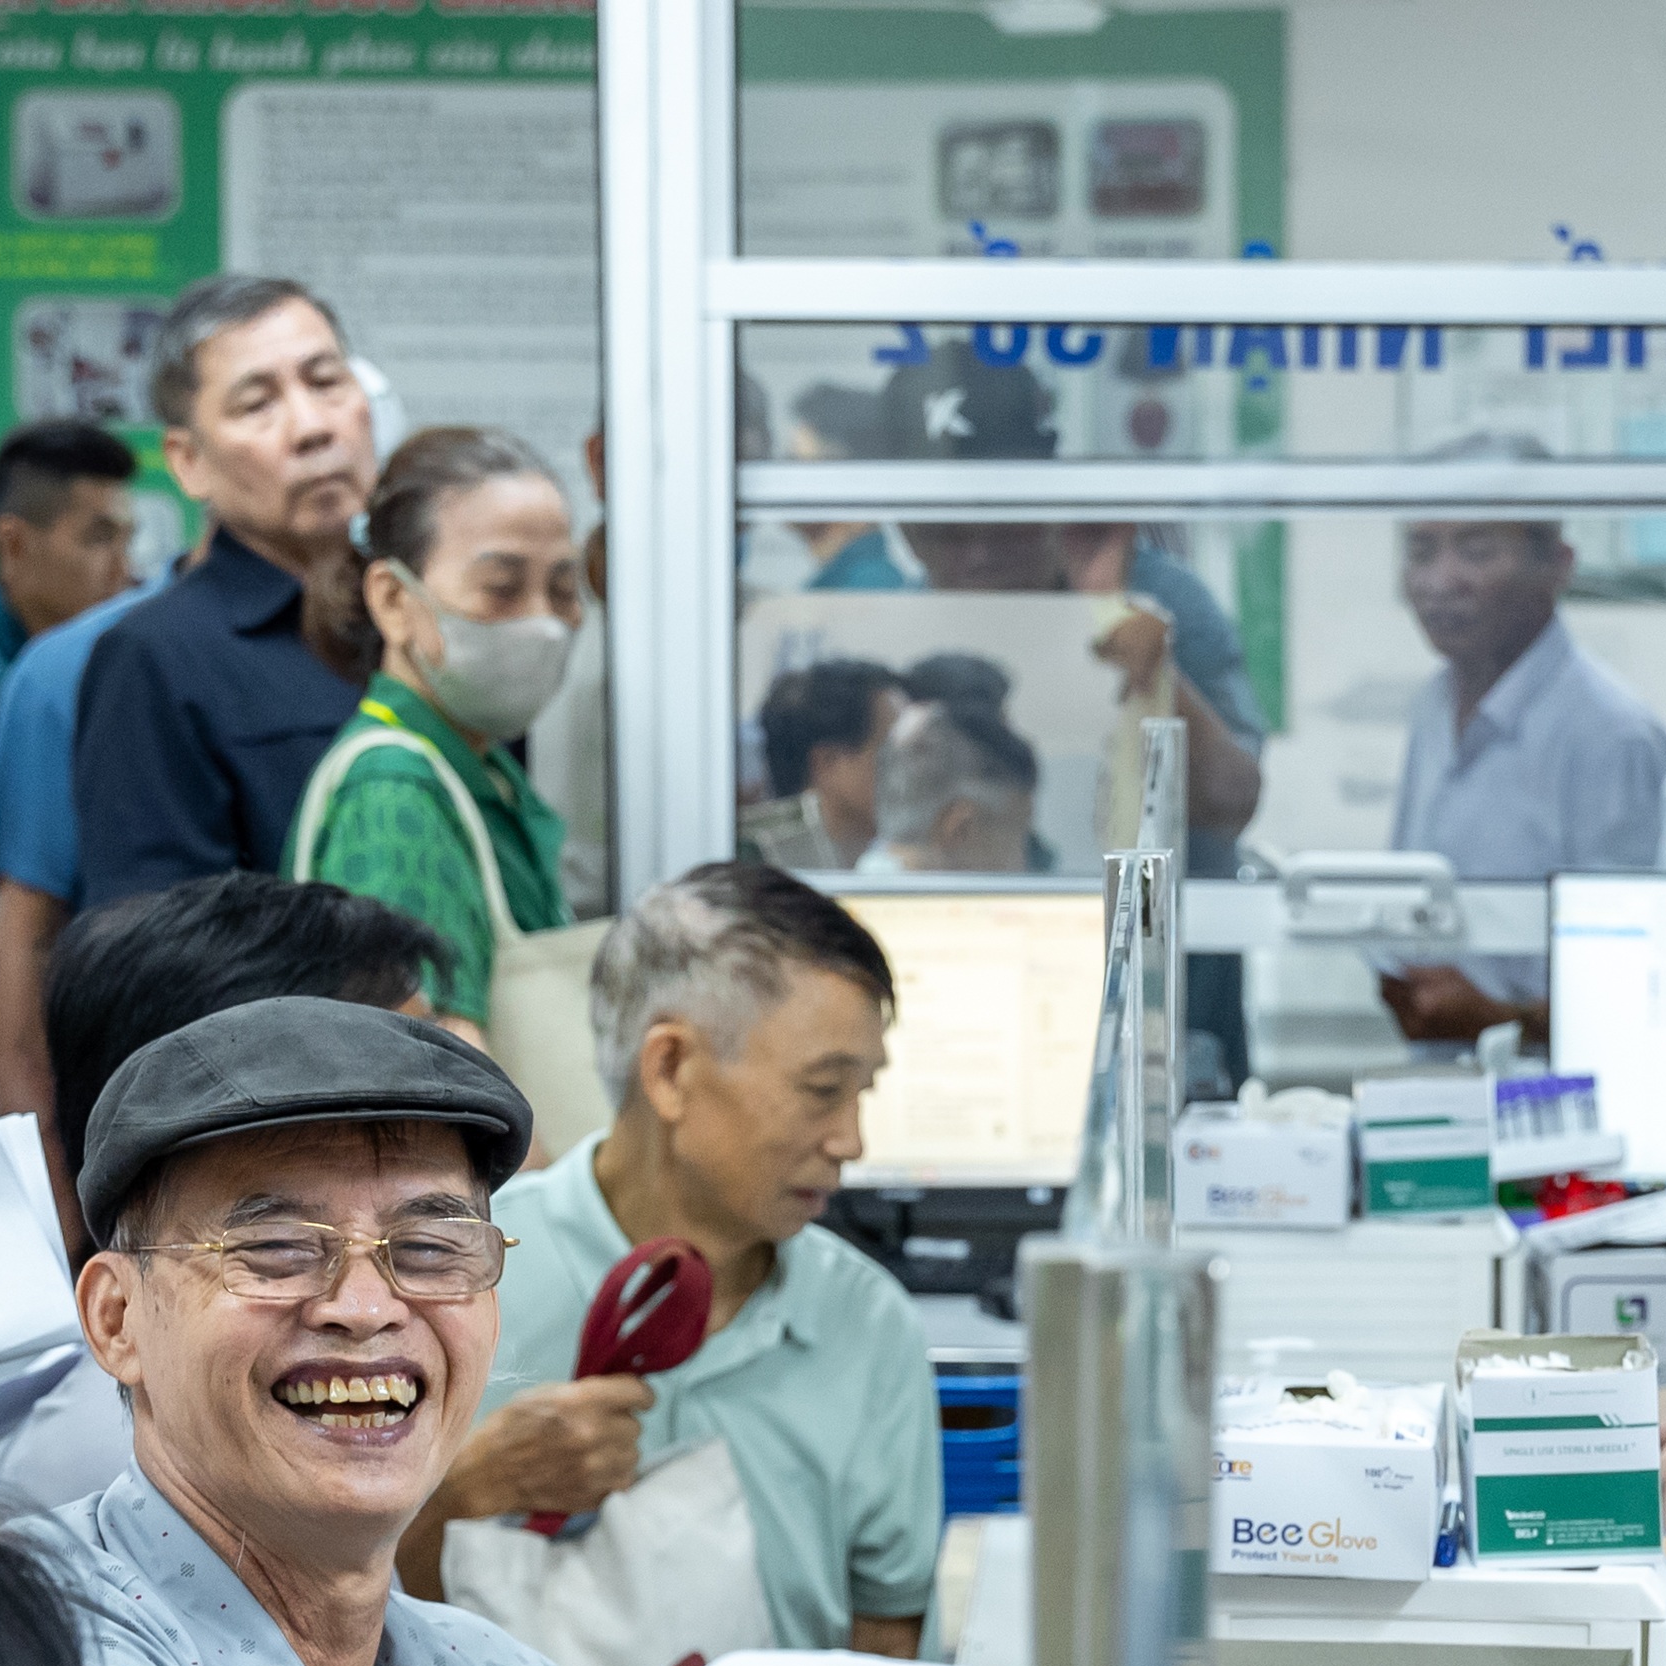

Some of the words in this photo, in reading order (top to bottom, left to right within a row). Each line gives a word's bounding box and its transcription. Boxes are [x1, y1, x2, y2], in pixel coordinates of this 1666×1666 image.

[1232, 1549, 1278, 1561] Protect
[1282, 1551, 1311, 1562] Your
[1315, 1553, 1339, 1563] Life
